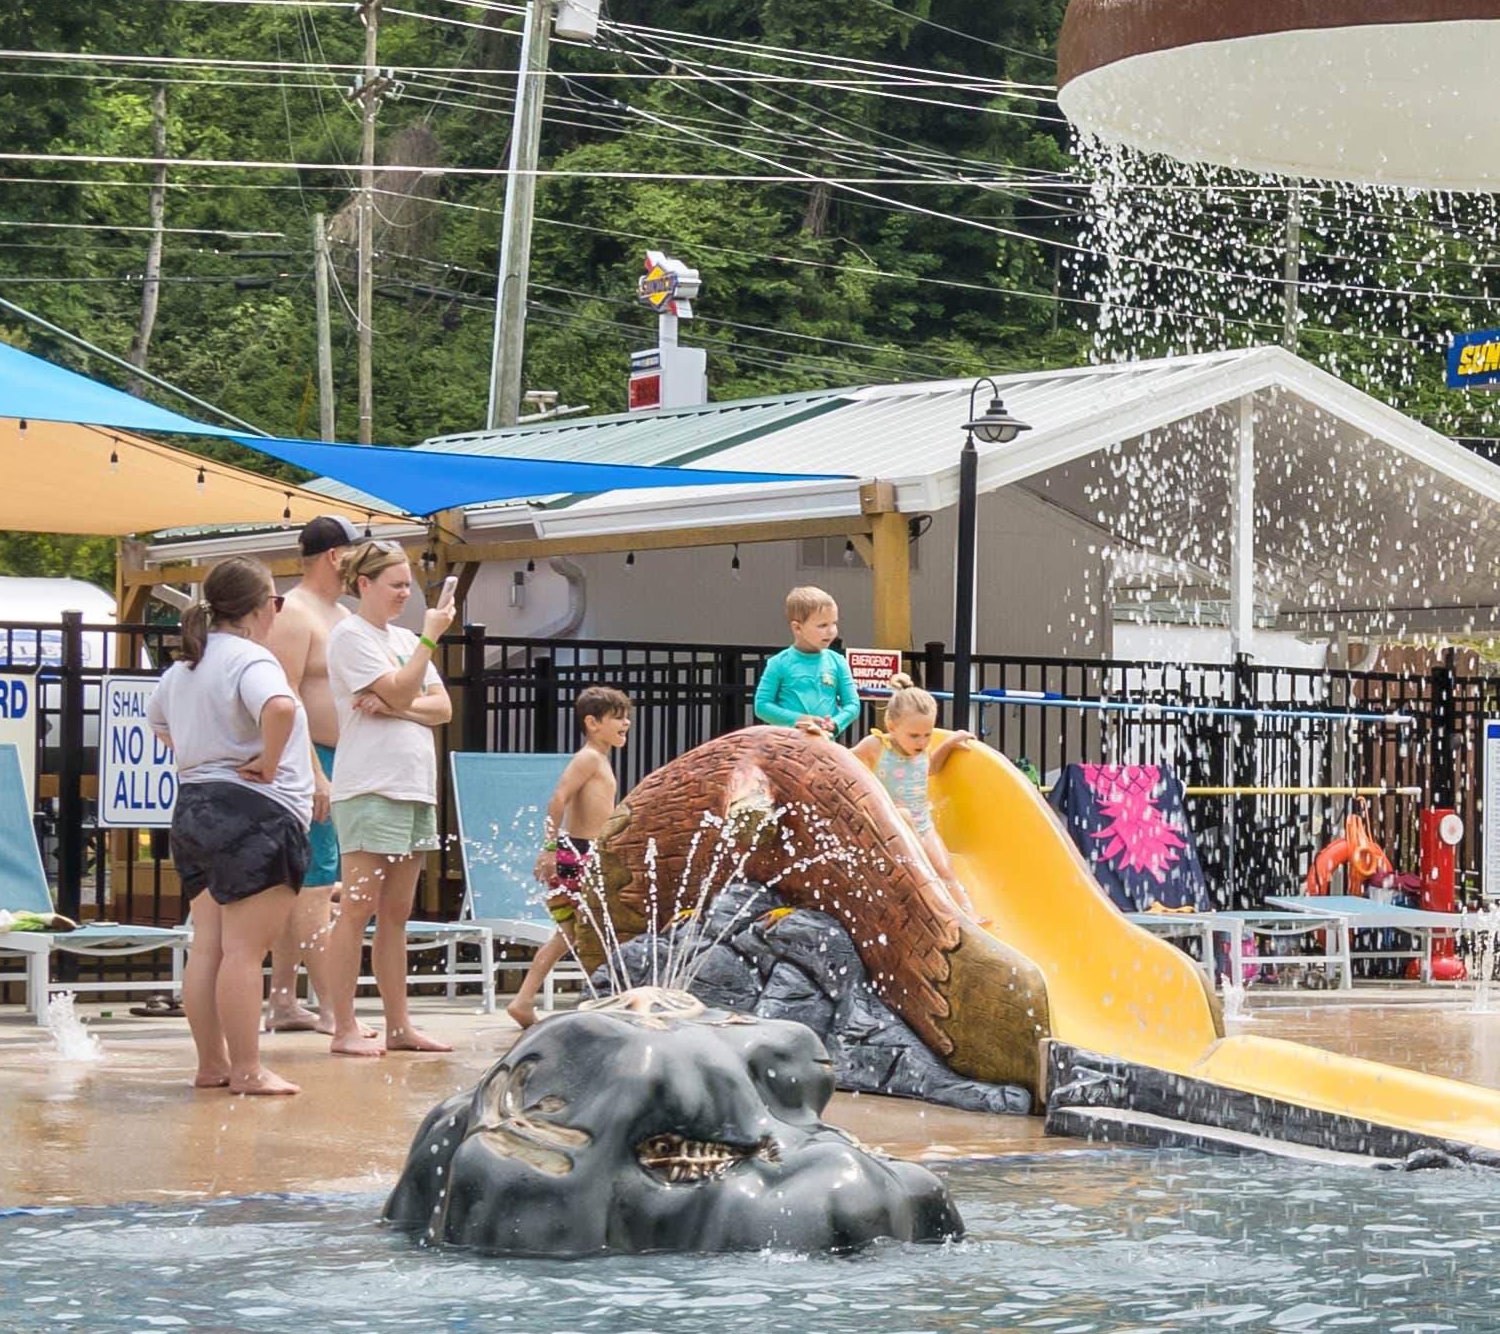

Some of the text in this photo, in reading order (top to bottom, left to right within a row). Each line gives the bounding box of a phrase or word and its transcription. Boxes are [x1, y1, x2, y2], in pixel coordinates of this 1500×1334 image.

[851, 654, 894, 667] EMERGENCY
[853, 667, 893, 678] SHUT-OFF
[112, 690, 151, 717] SHAL
[112, 725, 144, 765] NO
[113, 770, 180, 810] ALLO
